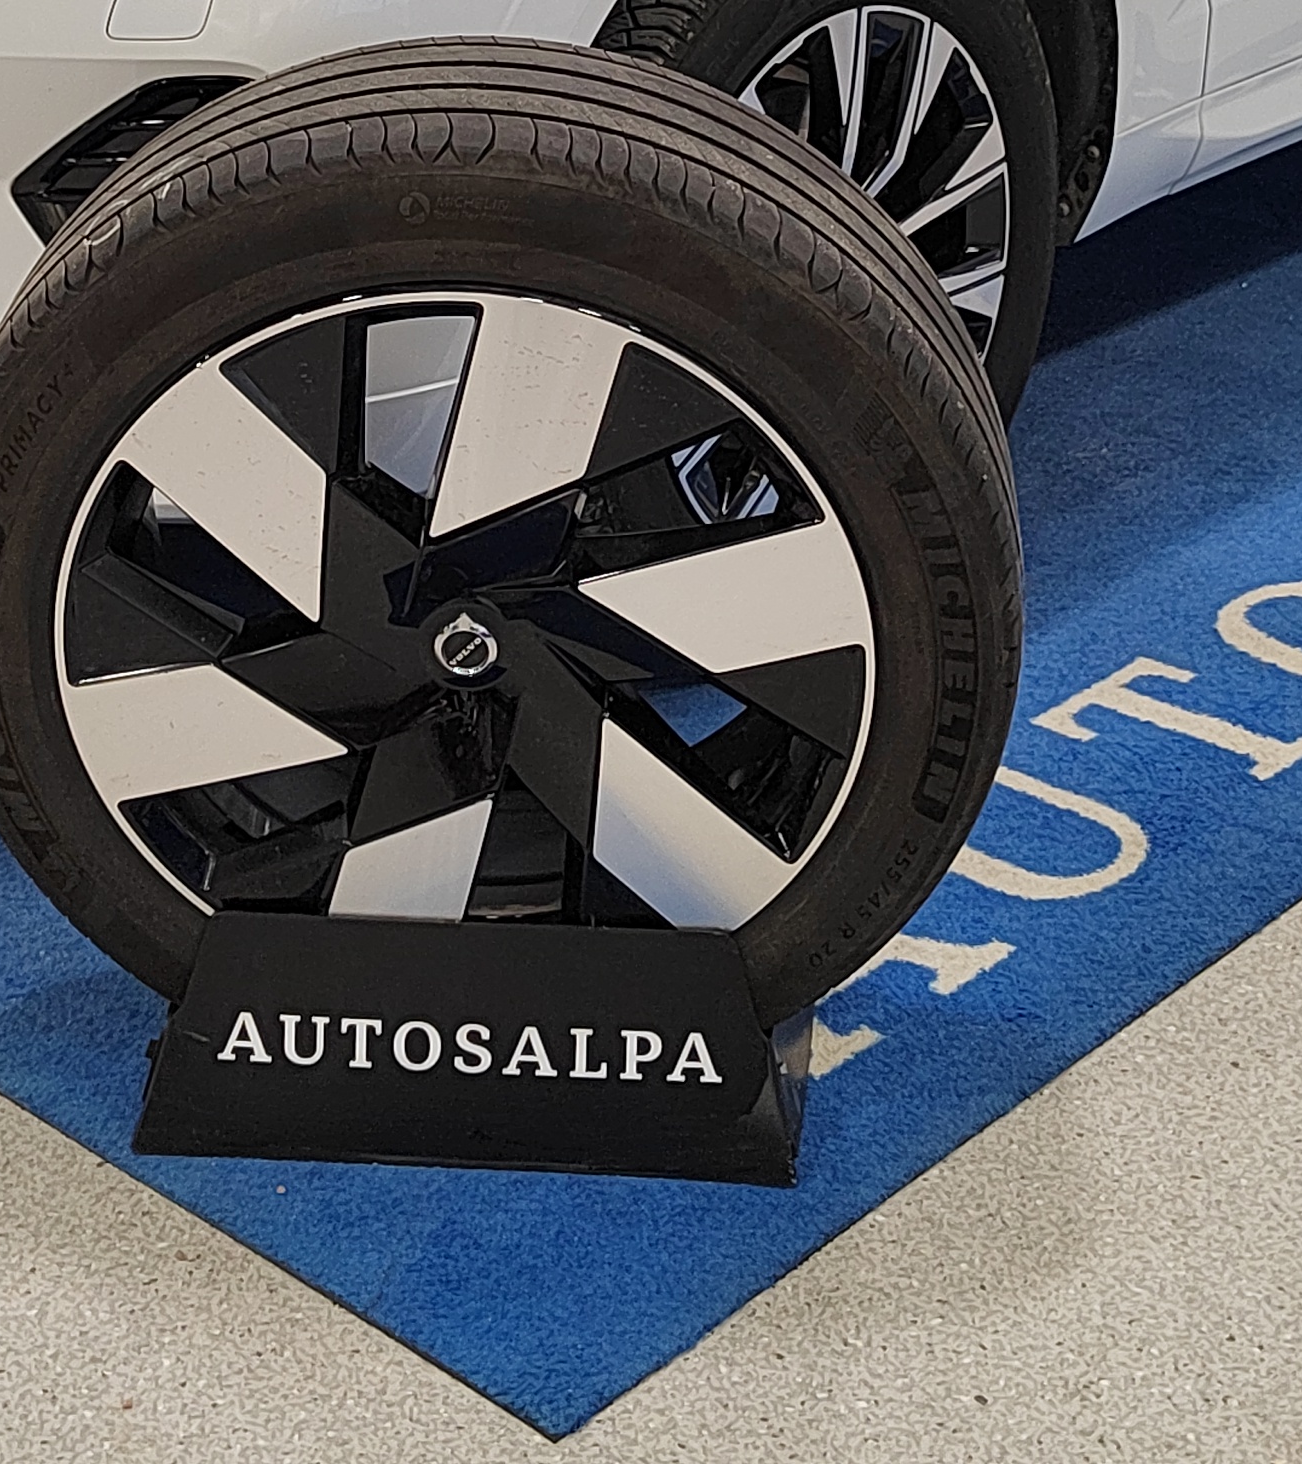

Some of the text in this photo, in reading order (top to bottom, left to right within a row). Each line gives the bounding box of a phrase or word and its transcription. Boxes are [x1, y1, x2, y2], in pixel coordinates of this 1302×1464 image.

[448, 636, 483, 666] VOLVO
[897, 482, 979, 811] MICHELIN
[807, 838, 919, 969] 255/45 R 20
[216, 1010, 724, 1085] AUTOSALPA
